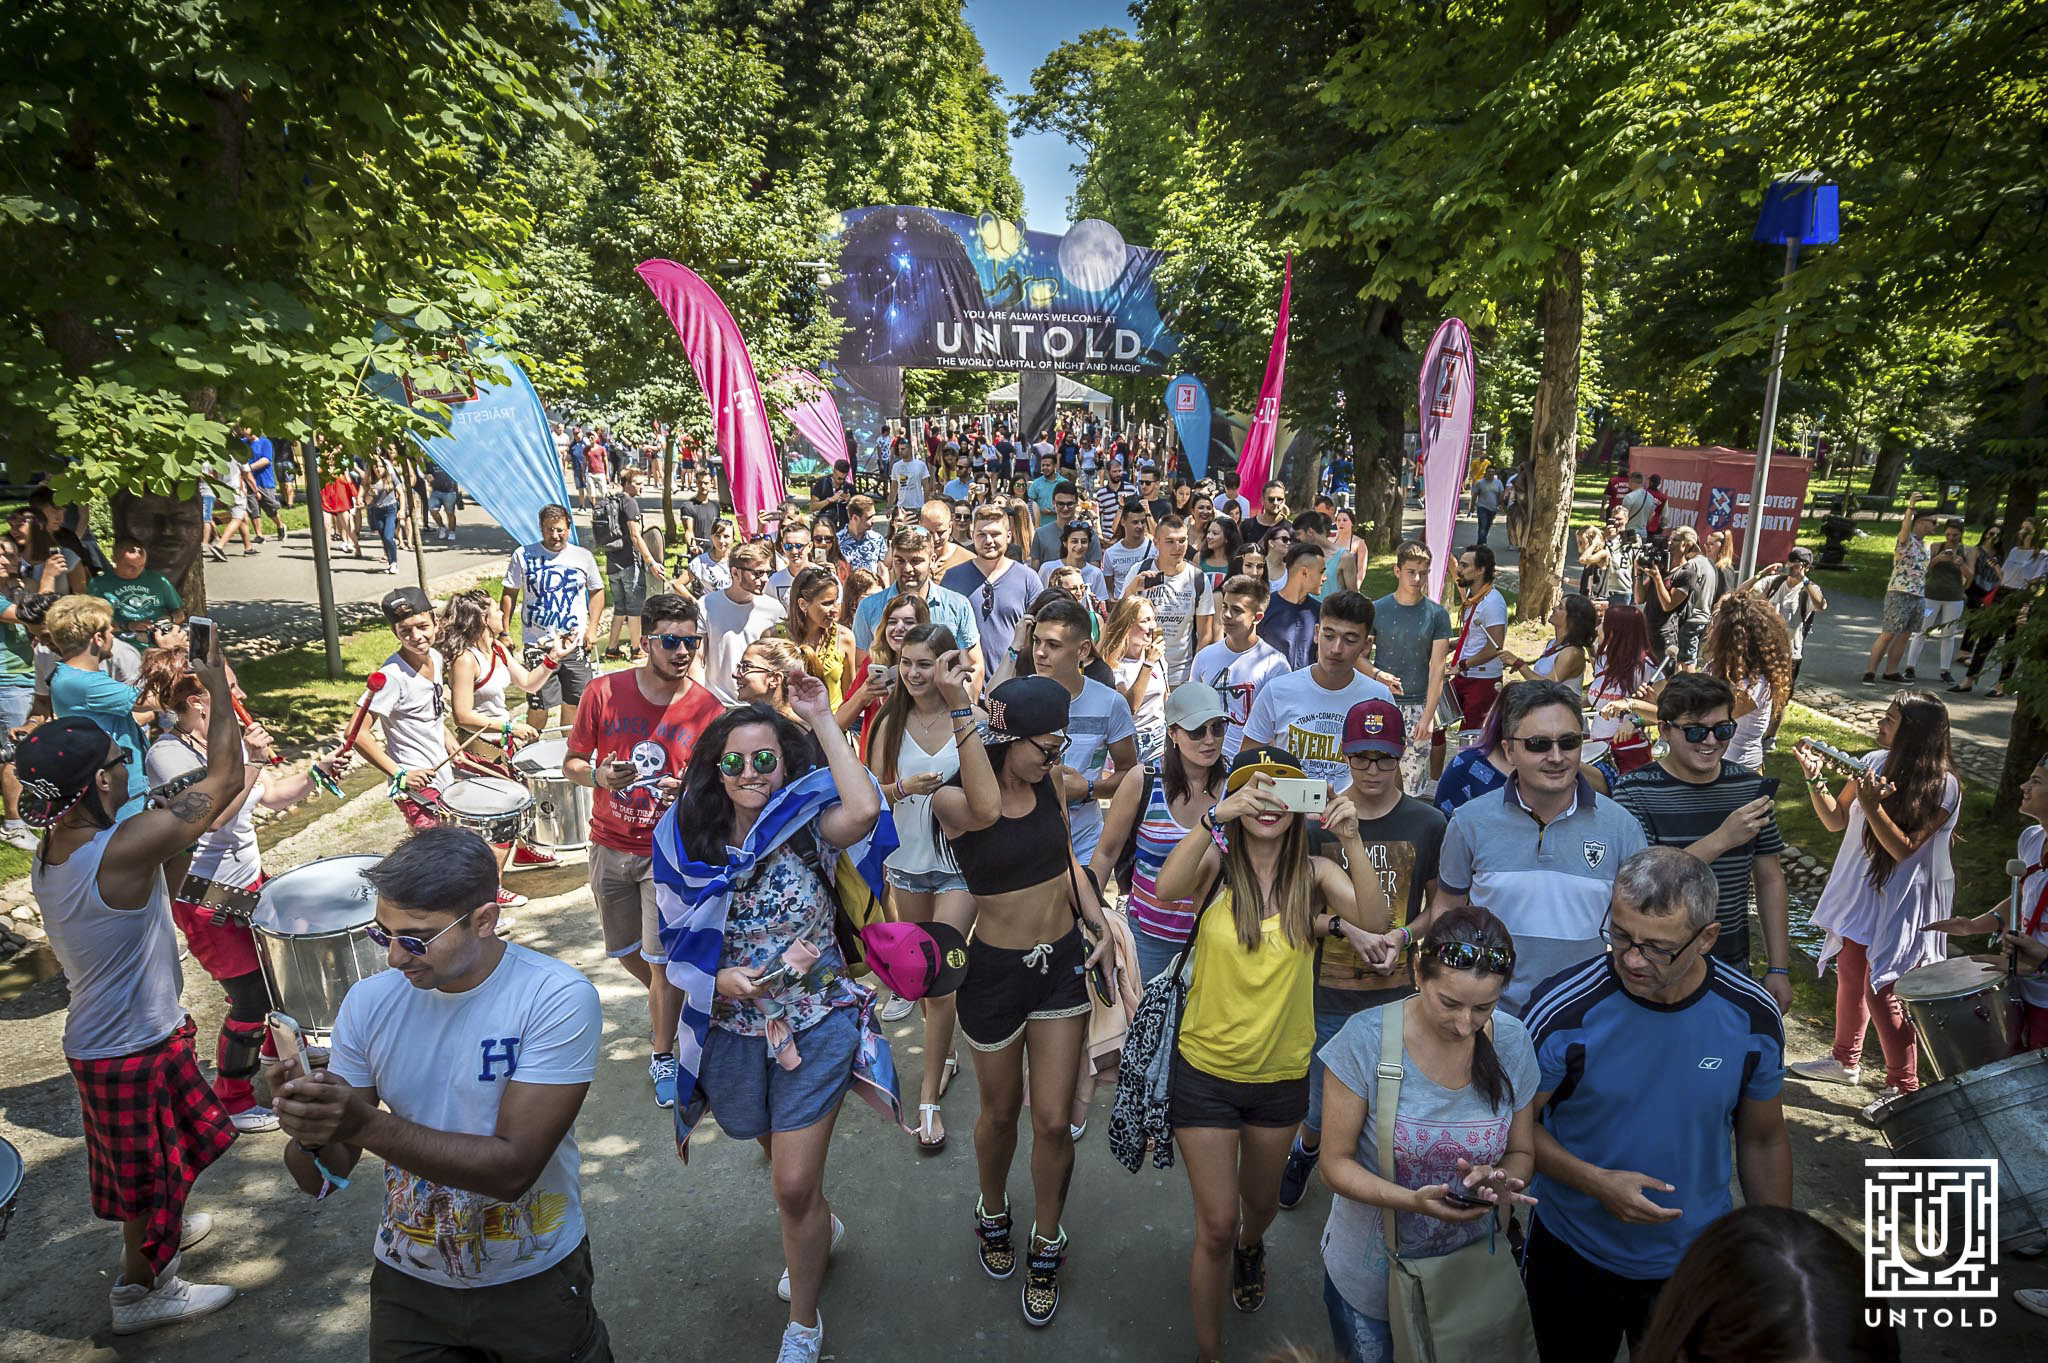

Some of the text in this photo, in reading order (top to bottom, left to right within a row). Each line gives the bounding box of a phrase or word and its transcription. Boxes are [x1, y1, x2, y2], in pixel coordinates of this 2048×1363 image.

[962, 310, 1117, 324] YOU ARE ALWAYS WELCOME AT
[936, 321, 1141, 360] UNTOLD
[936, 356, 1141, 373] THE WORLD CAPITAL OF NIGHT AND MAGIC
[1662, 479, 1703, 501] PROTECT
[1733, 512, 1794, 532] SEURITY
[525, 567, 578, 596] RIDE
[536, 586, 579, 613] ANY
[526, 604, 579, 631] THING
[1154, 615, 1185, 625] mpany
[1298, 712, 1345, 725] TRAIN COMPETE
[1315, 720, 1342, 735] BOXING
[1289, 724, 1345, 763] EVERLA
[1309, 760, 1338, 770] BRONX NY
[612, 809, 656, 825] YOU PUT THEM
[619, 804, 635, 816] TAKE
[478, 1038, 520, 1081] H
[985, 1228, 1008, 1238] adidas
[1032, 1261, 1056, 1269] adidas
